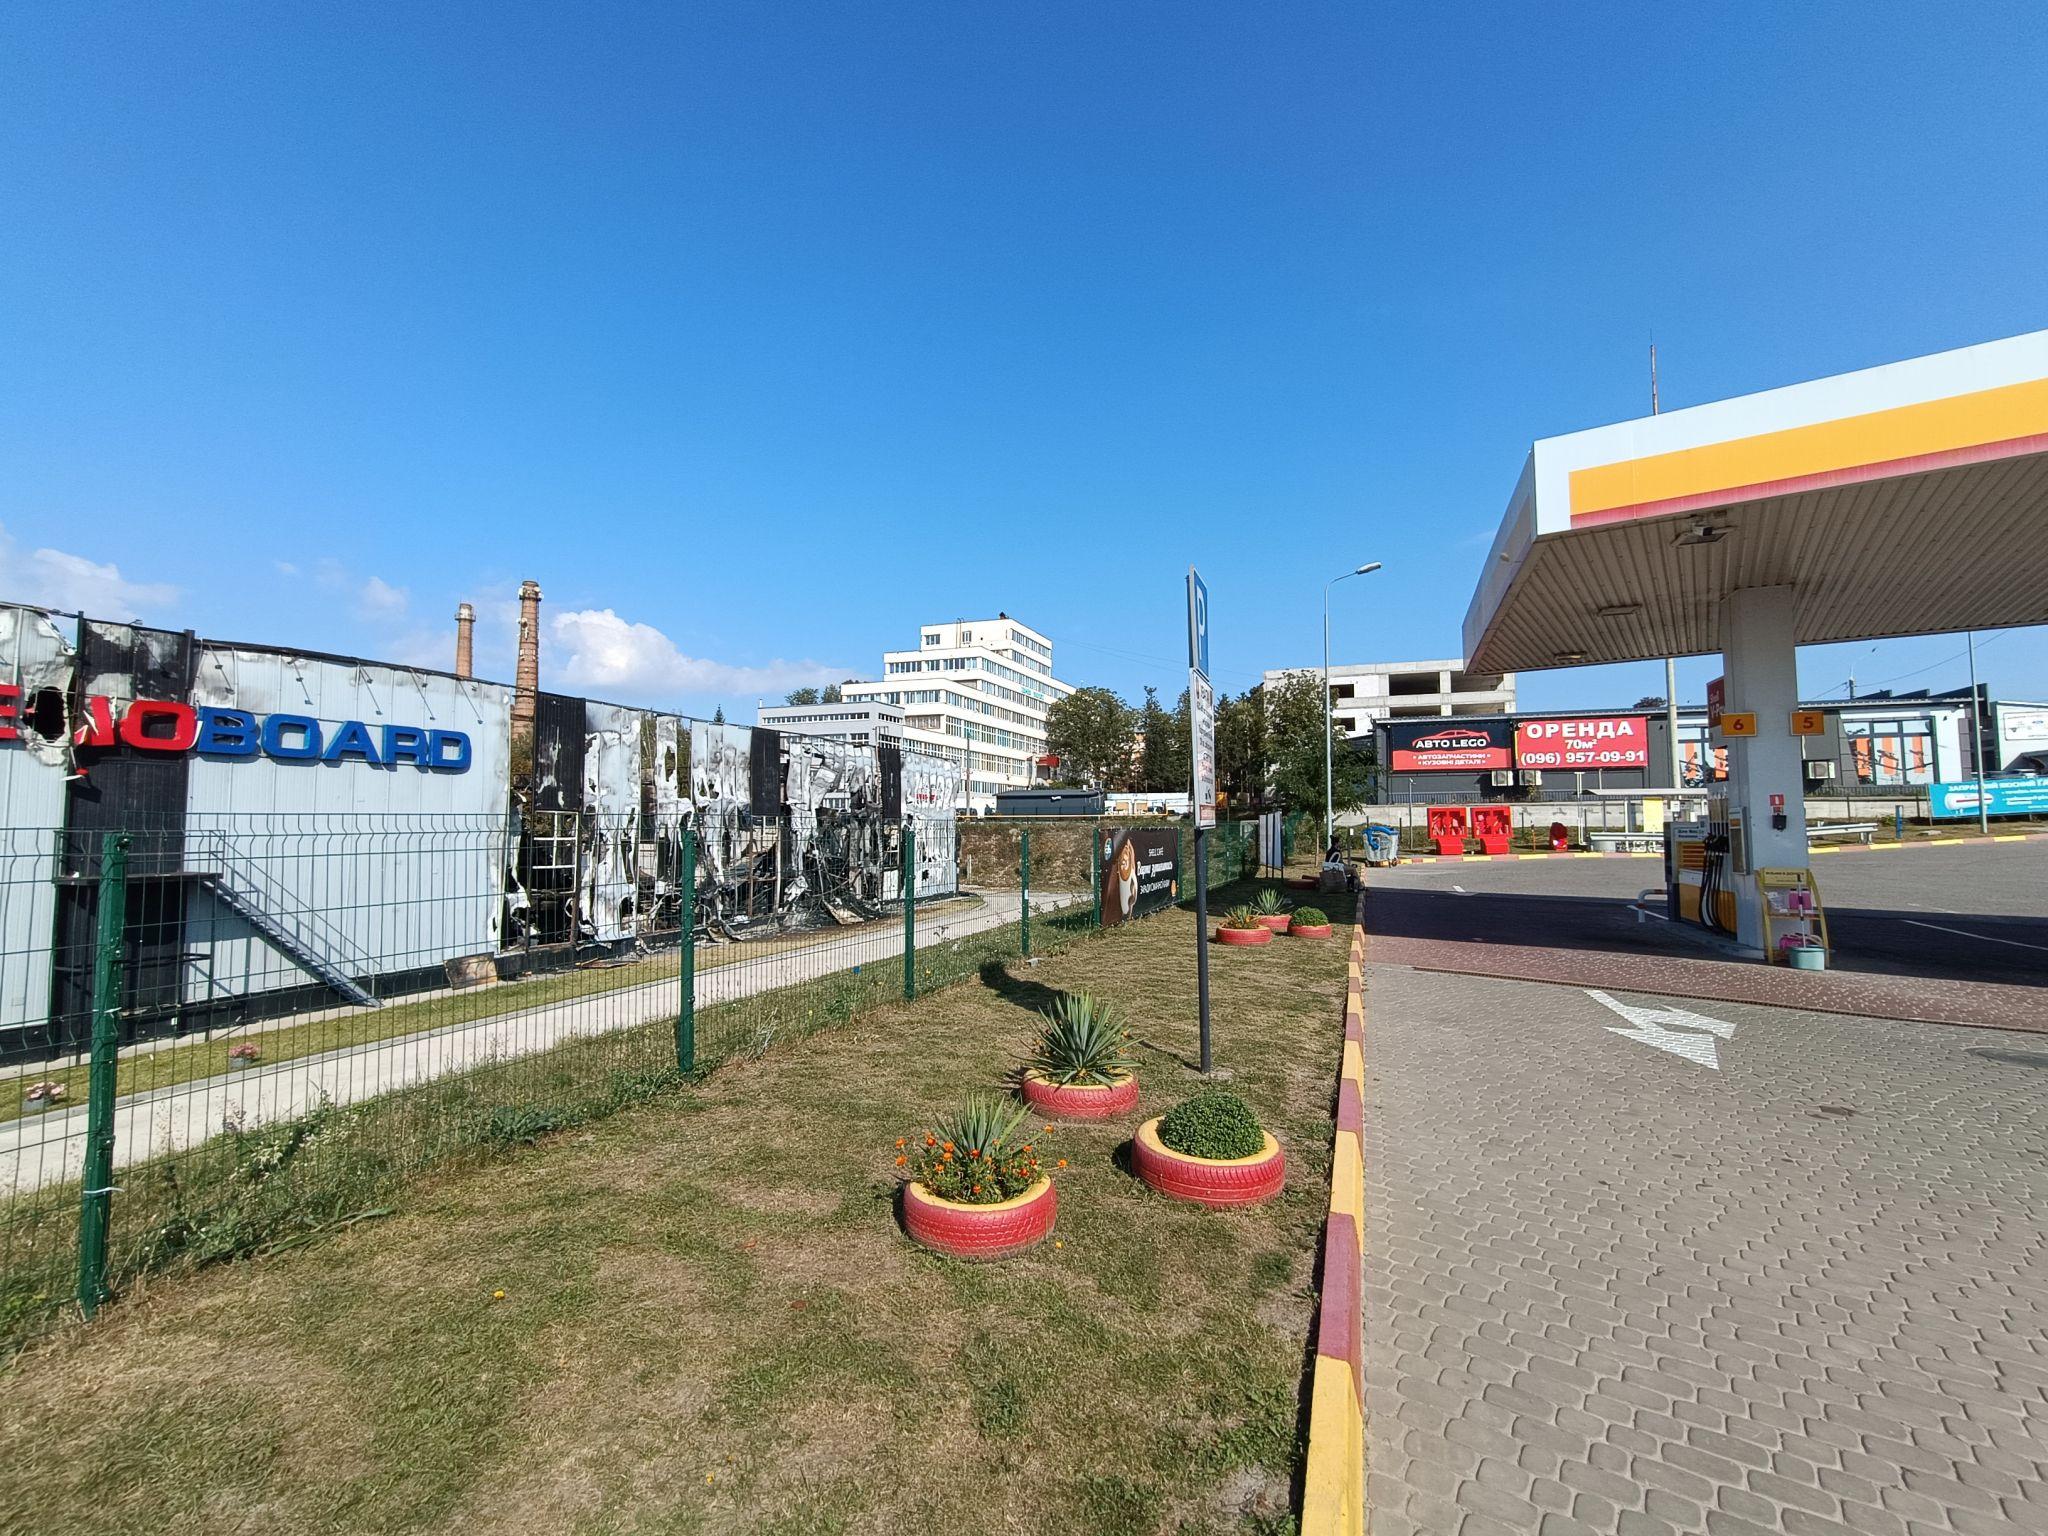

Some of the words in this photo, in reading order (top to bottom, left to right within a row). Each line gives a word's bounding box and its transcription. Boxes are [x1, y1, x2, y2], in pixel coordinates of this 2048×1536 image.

[1196, 585, 1205, 660] P
[0, 684, 472, 769] OBOARD
[1526, 720, 1634, 739] ОРЕНДА
[1733, 719, 1744, 730] 6
[1803, 717, 1814, 729] 5
[1416, 739, 1450, 749] АВТО
[1452, 738, 1487, 748] LEGO
[1520, 752, 1561, 765] (096)
[1565, 750, 1645, 763] 957-09-91
